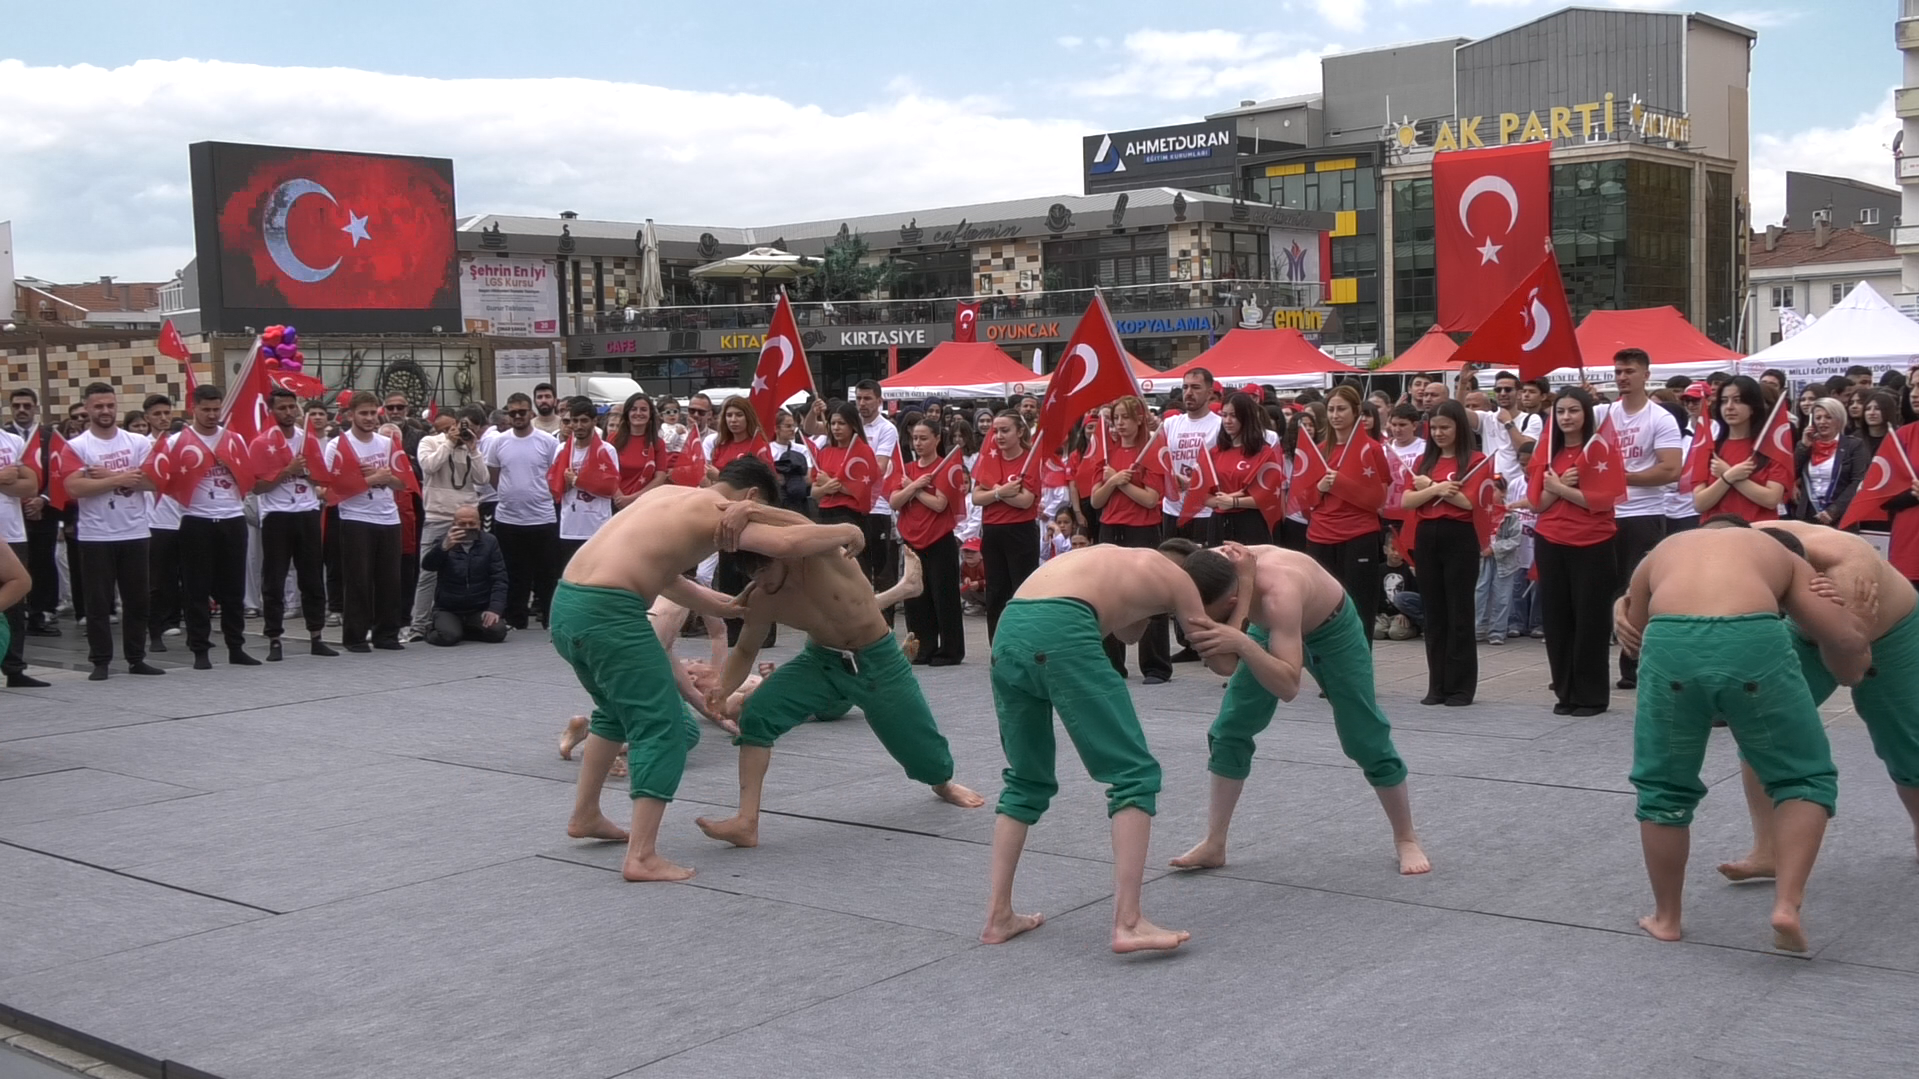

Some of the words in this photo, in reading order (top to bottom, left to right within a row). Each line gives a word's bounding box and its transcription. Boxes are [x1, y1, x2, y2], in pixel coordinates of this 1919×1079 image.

[1433, 115, 1484, 151] AK
[1500, 92, 1615, 145] PARTİ
[1125, 131, 1230, 157] AHMETDURAN
[470, 264, 511, 280] Şehrin
[514, 266, 528, 277] En
[531, 264, 546, 281] İyi
[485, 277, 502, 287] LGS
[505, 278, 534, 288] Kursu
[1116, 316, 1211, 334] KOPYALAMA
[1274, 310, 1322, 329] emin
[841, 328, 926, 346] KIRTASİYE
[986, 322, 1061, 340] OYUNCAK
[606, 340, 637, 353] CAFE
[1788, 367, 1809, 376] MİLLİ
[1810, 366, 1838, 375] EĞİTİM
